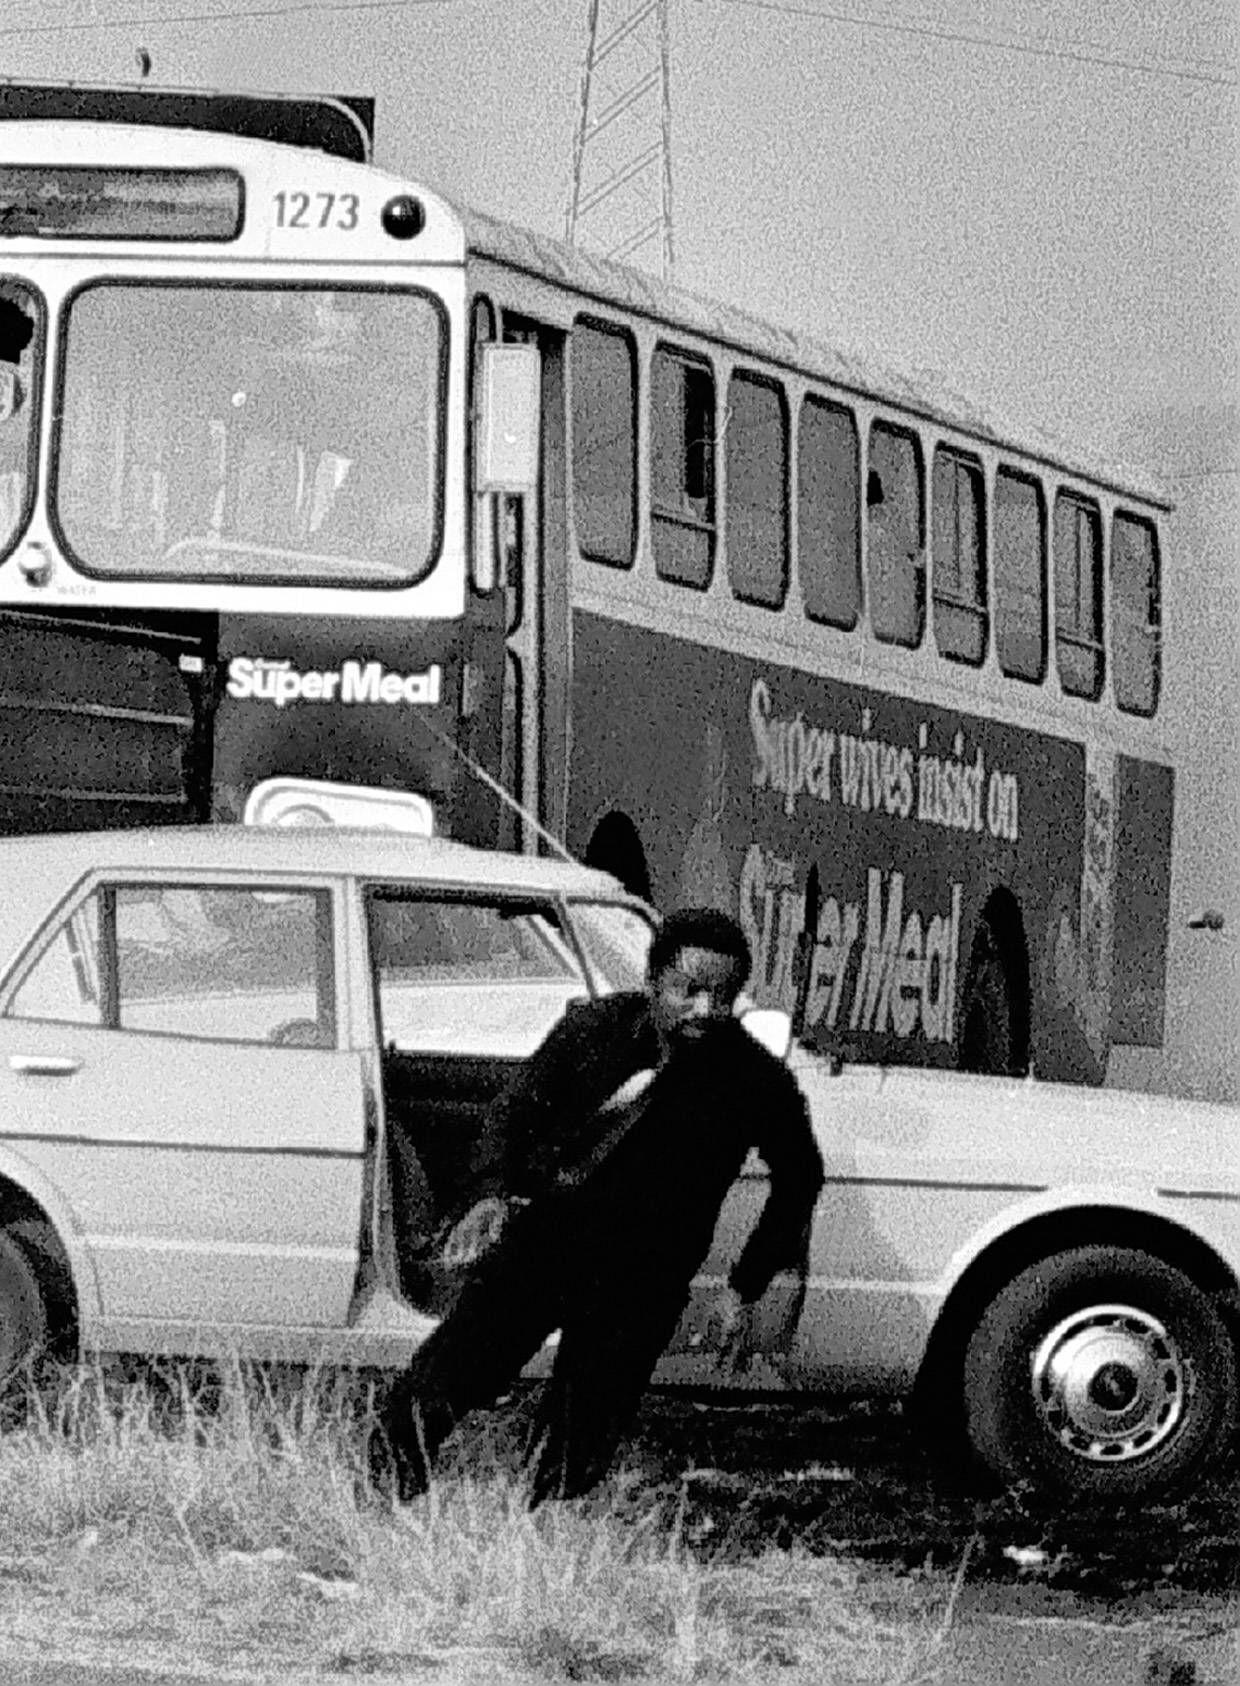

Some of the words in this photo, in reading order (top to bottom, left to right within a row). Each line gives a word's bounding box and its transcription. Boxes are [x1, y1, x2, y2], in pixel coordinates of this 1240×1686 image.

[273, 191, 360, 230] 1273
[227, 656, 339, 707] Super
[341, 660, 442, 704] Meal
[750, 679, 835, 815] Super
[840, 707, 912, 818] wives
[918, 722, 985, 833] insist
[989, 770, 1018, 841] on
[849, 866, 963, 1046] Meal
